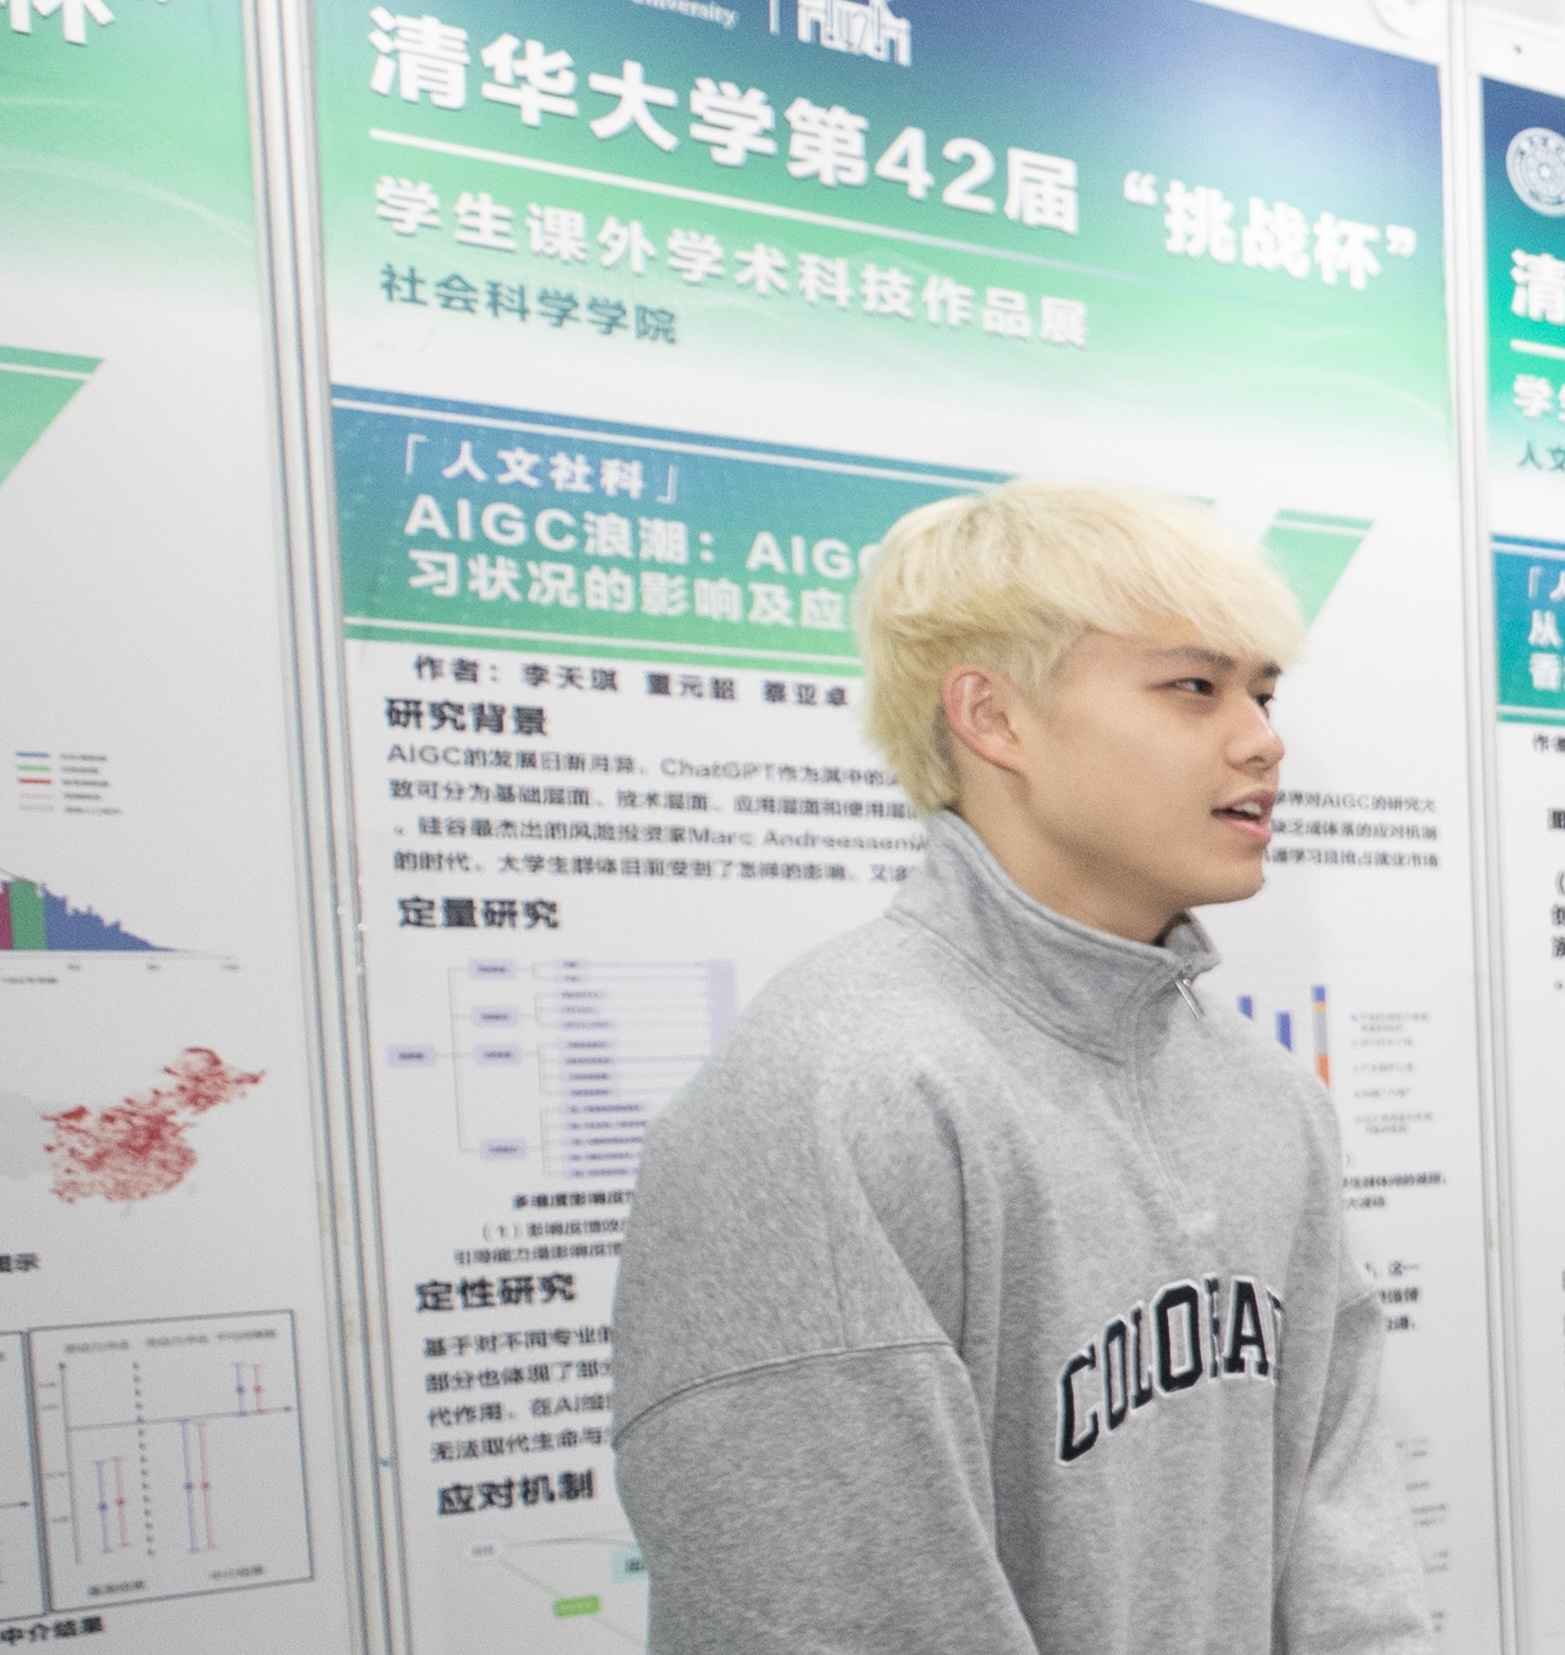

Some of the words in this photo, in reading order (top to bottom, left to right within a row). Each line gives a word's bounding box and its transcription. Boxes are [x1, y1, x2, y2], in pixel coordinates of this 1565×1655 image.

[375, 175, 1088, 348] 学生课外学术科技作品展
[380, 263, 678, 345] 社会科学学院
[386, 697, 547, 736] 研究背景
[397, 896, 559, 930] 定量研究
[414, 1271, 577, 1313] 定性研究
[437, 1468, 595, 1517] 应对机制
